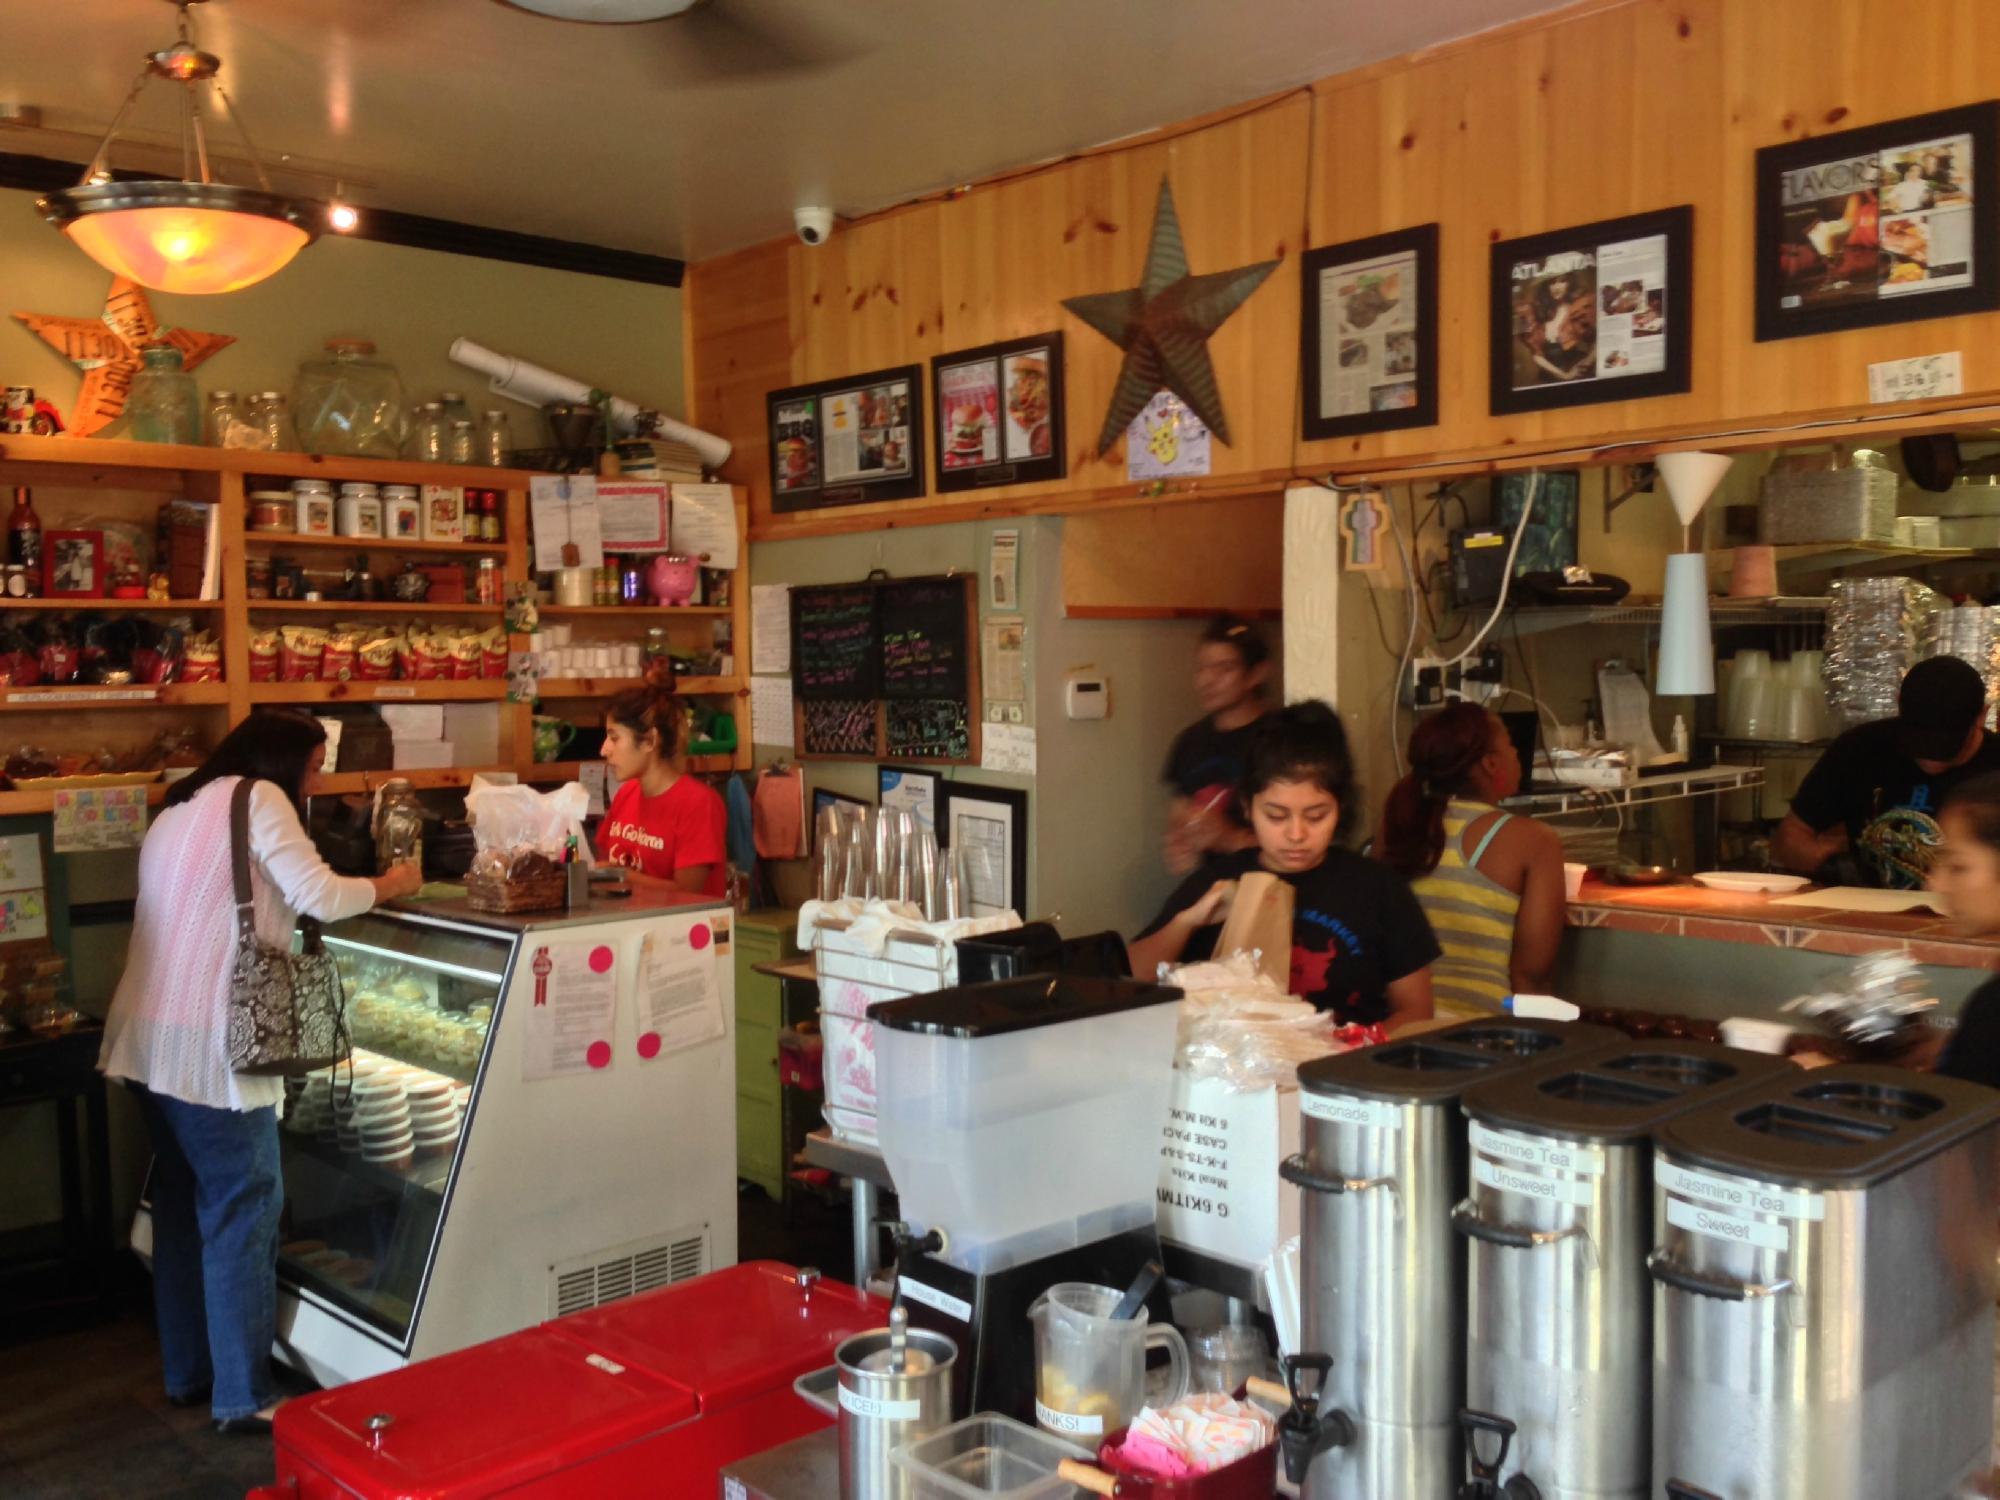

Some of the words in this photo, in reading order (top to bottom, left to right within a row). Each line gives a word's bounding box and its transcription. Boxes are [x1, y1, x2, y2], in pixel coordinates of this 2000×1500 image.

[1782, 157, 1881, 198] FLAVORS
[1512, 251, 1597, 280] ATLANTA
[1199, 1114, 1217, 1129] Kit
[1308, 1101, 1369, 1122] Lemonade
[1220, 1118, 1229, 1130] 6
[1194, 1133, 1228, 1151] CASE
[1482, 1134, 1534, 1160] Jasmine
[1538, 1148, 1570, 1167] Tea
[1171, 1167, 1196, 1182] Kits
[1199, 1174, 1229, 1190] Meal
[1492, 1168, 1557, 1197] Unsweet
[1675, 1173, 1743, 1204] Jasmine
[1747, 1190, 1785, 1212] Tea
[1217, 1203, 1229, 1218] G
[1696, 1212, 1751, 1240] Sweet
